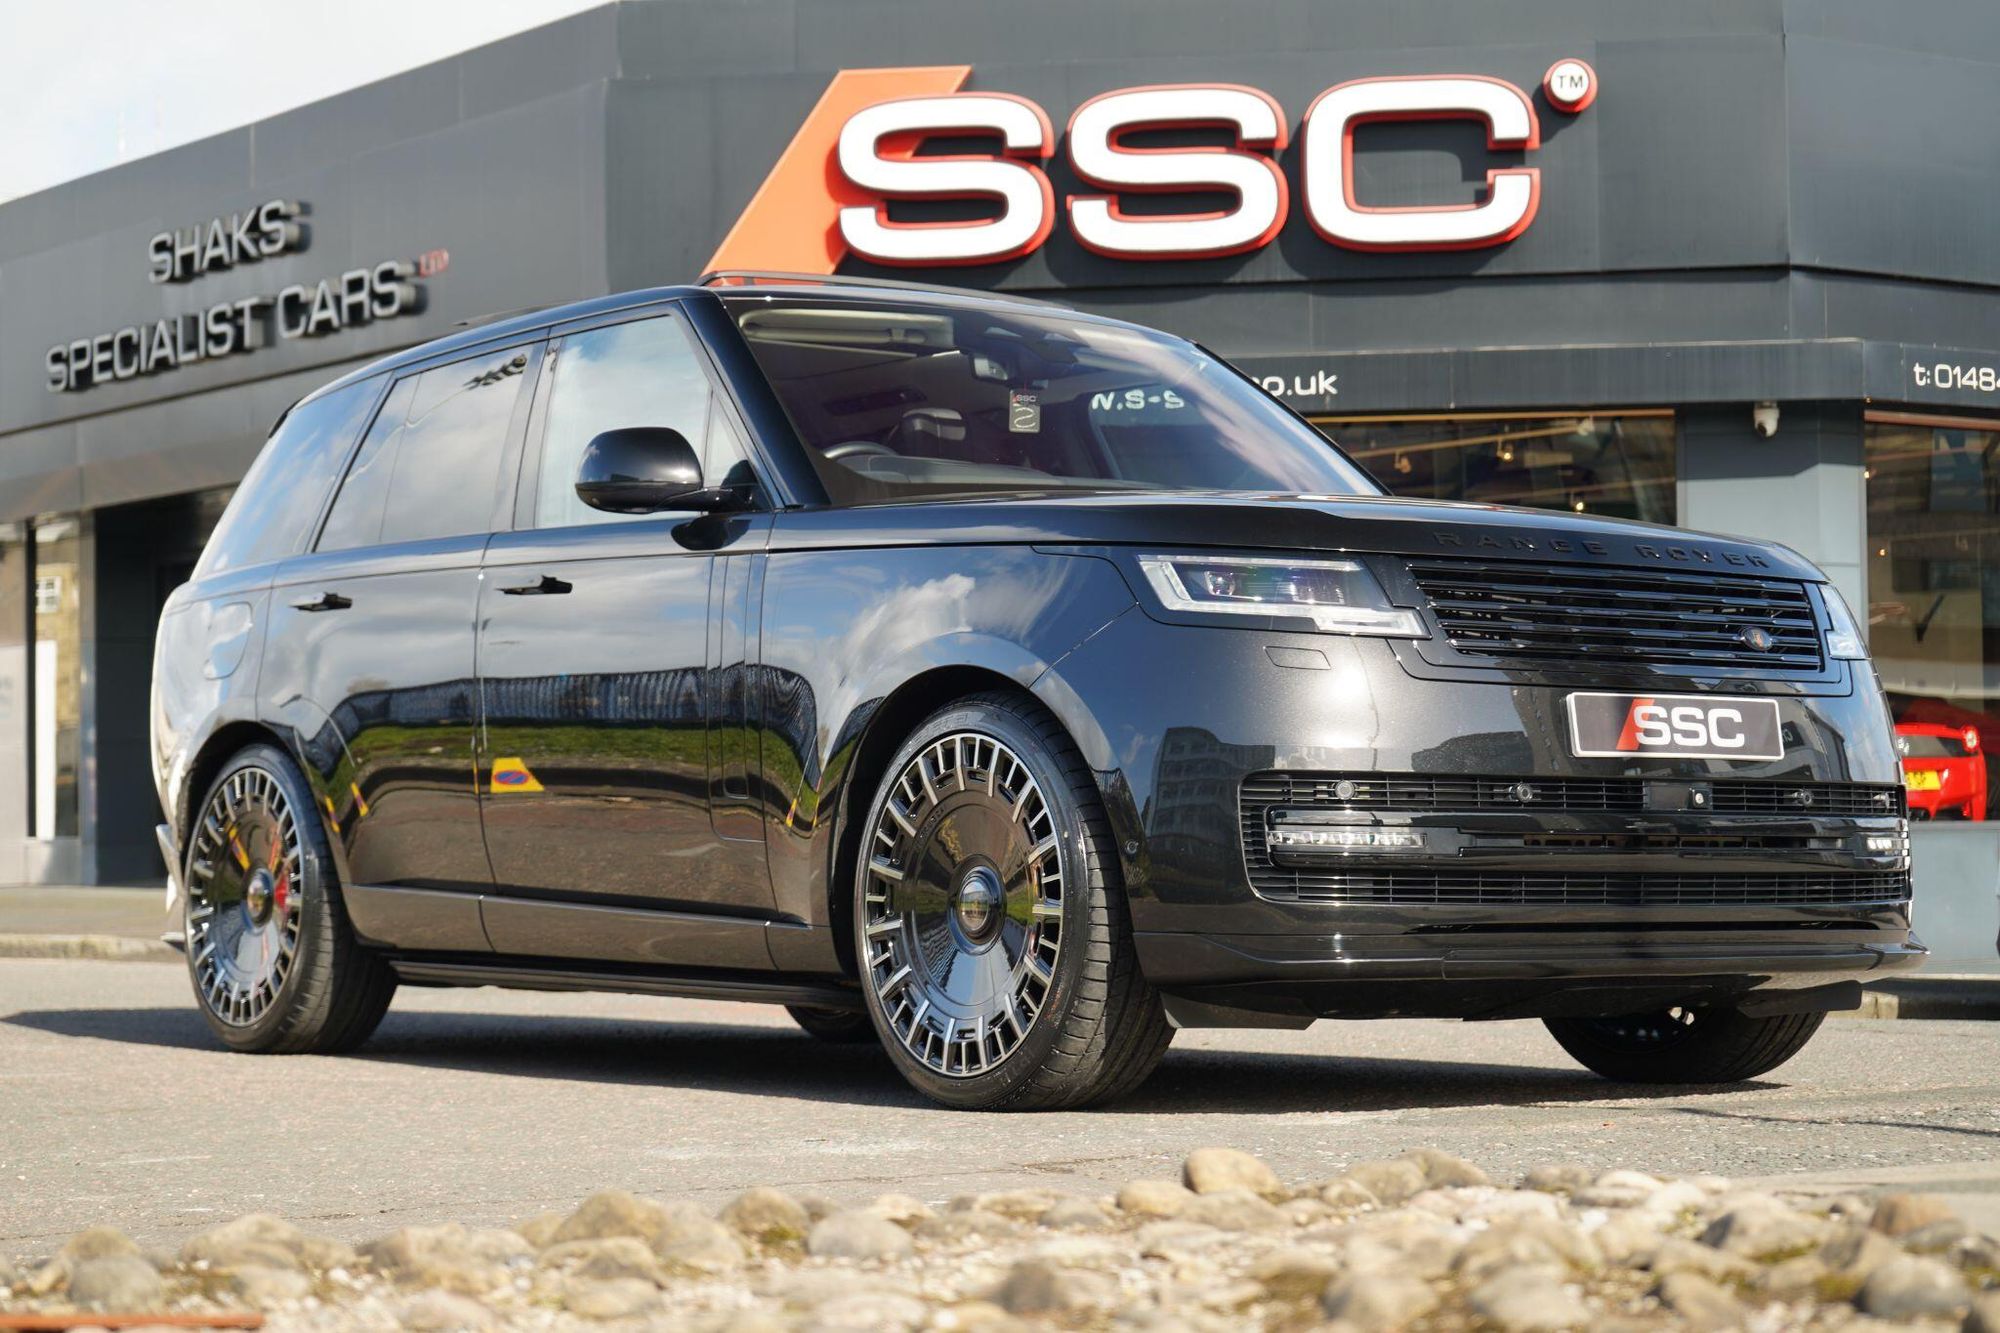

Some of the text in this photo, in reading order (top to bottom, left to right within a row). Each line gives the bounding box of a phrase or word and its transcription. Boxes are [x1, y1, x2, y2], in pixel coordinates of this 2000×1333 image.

[837, 74, 1584, 267] SSC TM
[148, 199, 288, 284] SHAKS
[45, 297, 262, 392] SPECIALIST
[276, 260, 404, 339] CARS
[1252, 369, 1338, 397] o.uk
[1913, 362, 2000, 392] t:0148
[1433, 531, 1770, 569] RANGE ROVER
[1633, 704, 1746, 749] SSC
